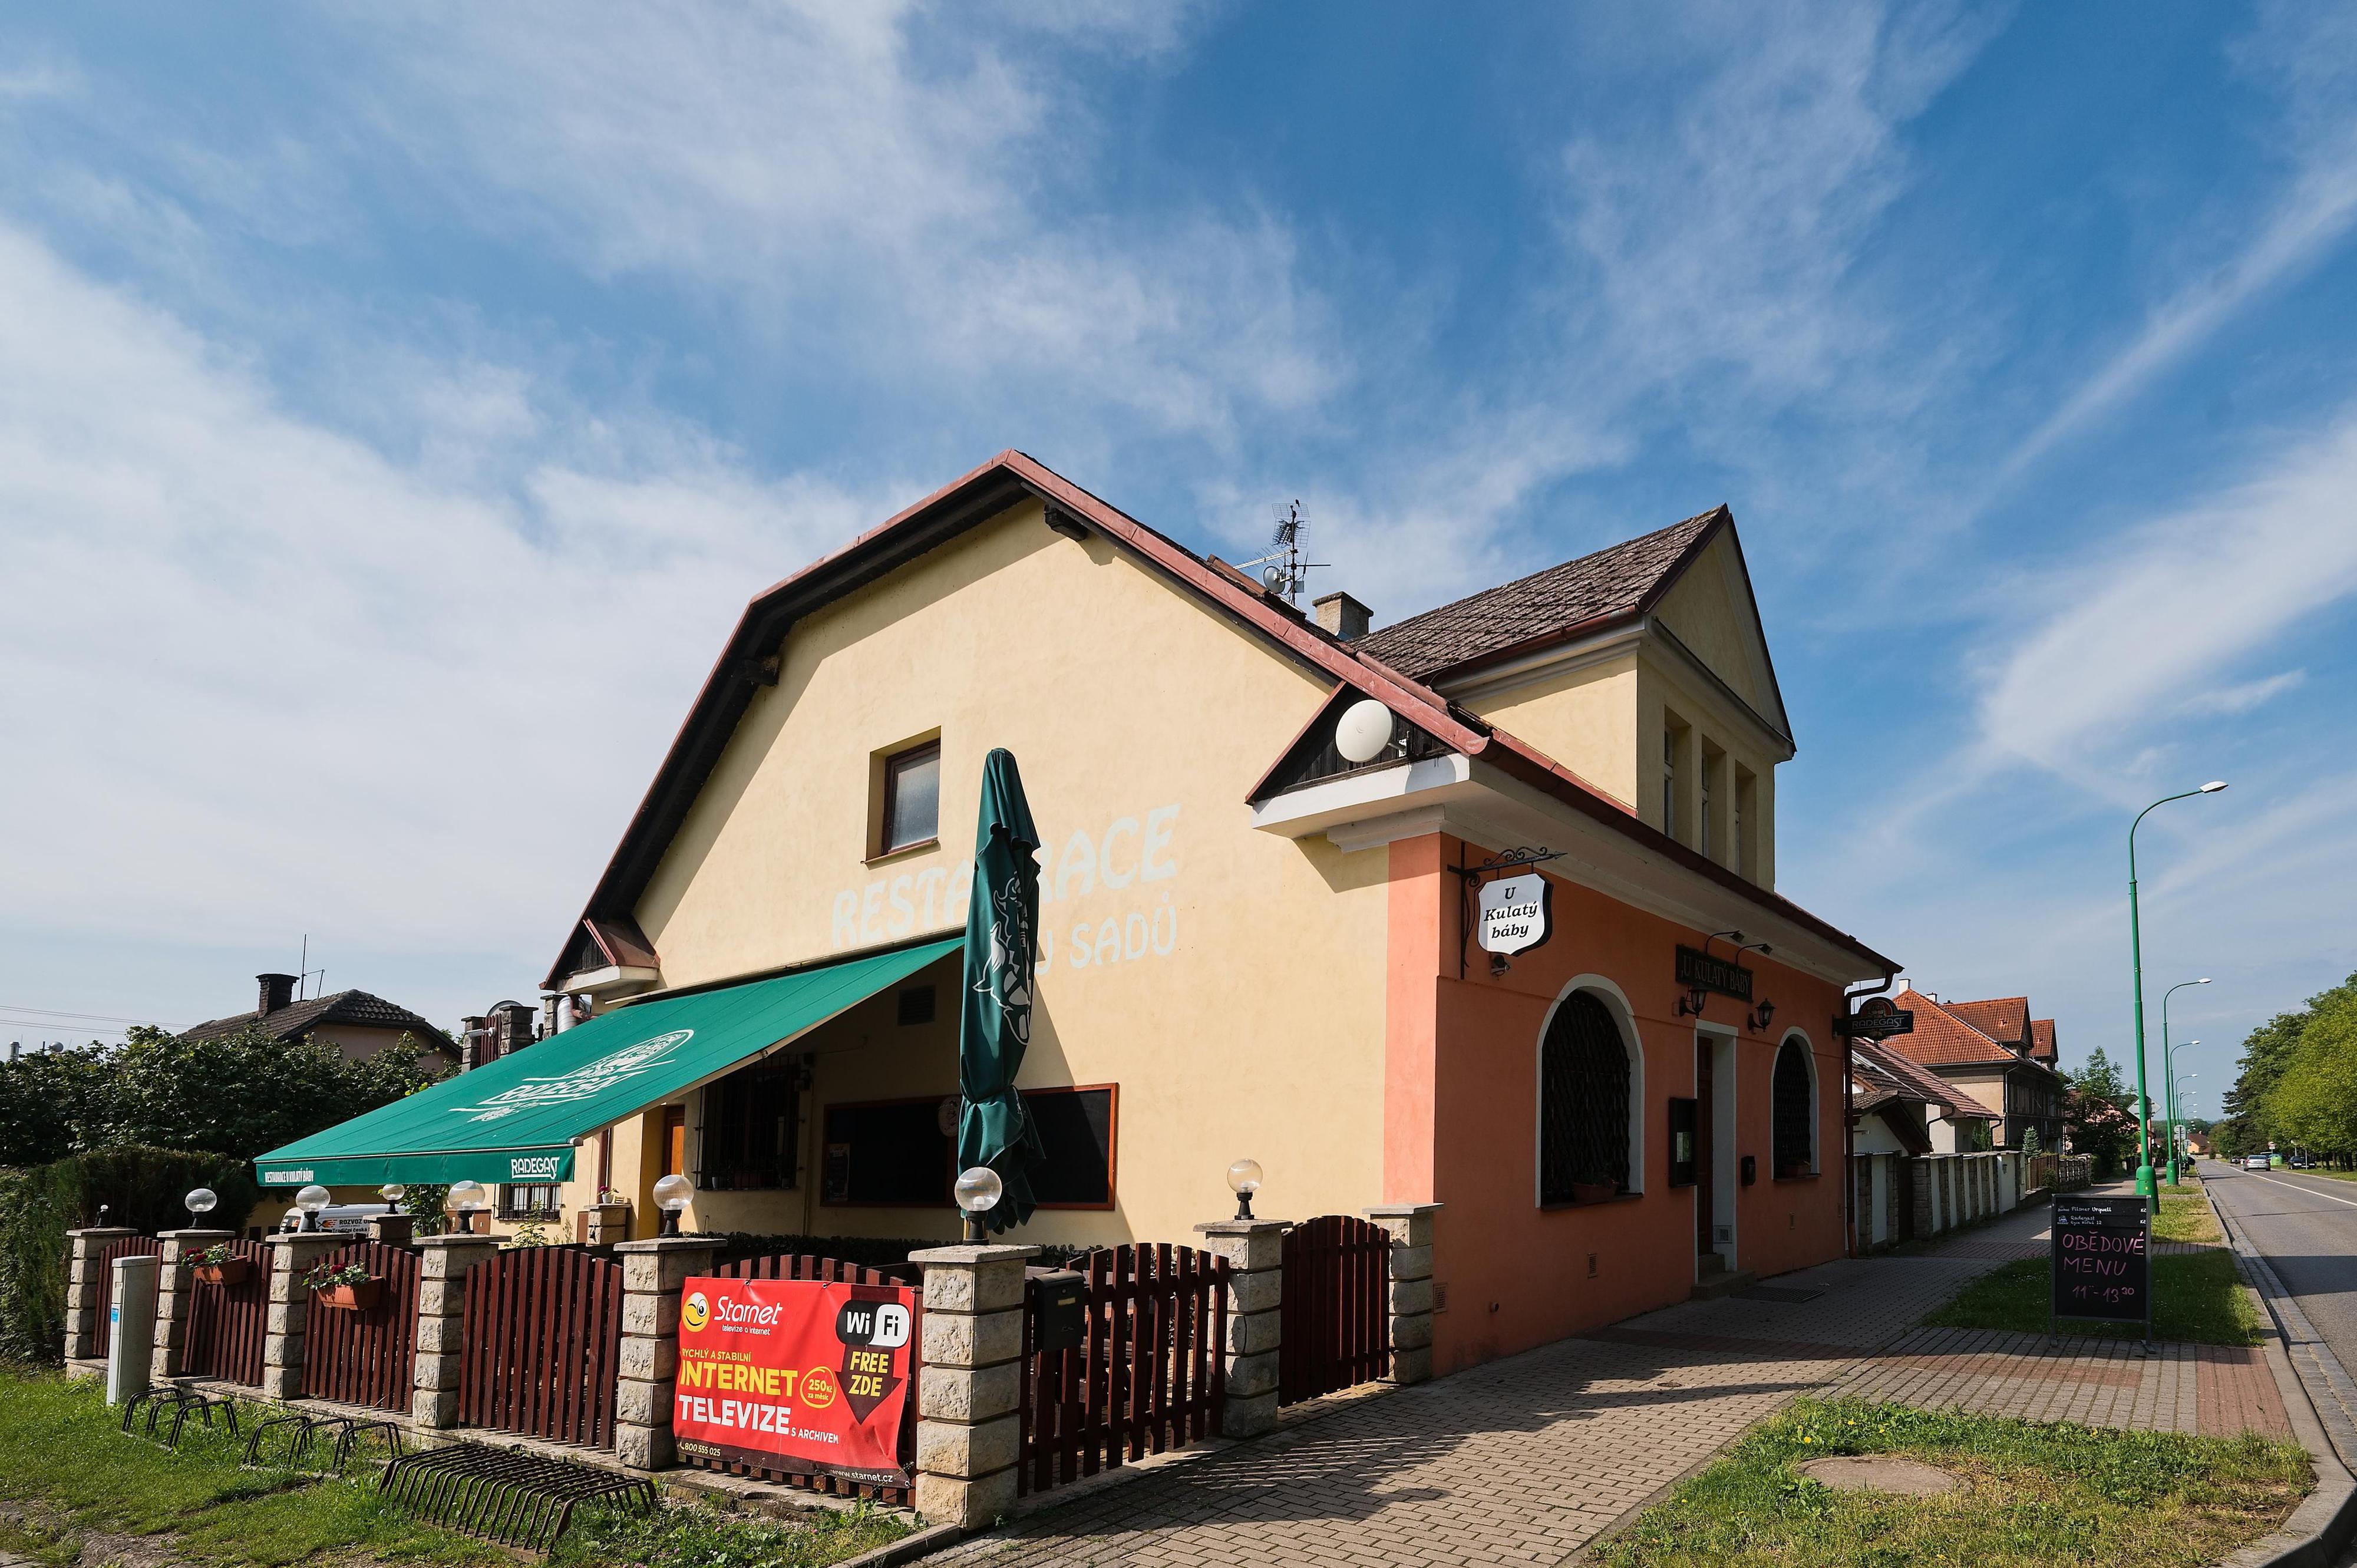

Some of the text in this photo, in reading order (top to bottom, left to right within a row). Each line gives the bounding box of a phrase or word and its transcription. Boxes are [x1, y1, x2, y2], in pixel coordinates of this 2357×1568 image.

[831, 803, 1181, 949] RESTARACE
[1505, 886, 1516, 900] U
[1484, 901, 1538, 922] Kulatý
[1069, 891, 1178, 969] SADŮ
[1491, 923, 1529, 939] báby
[1695, 959, 1728, 988] KULATÝ
[1729, 968, 1750, 995] BÁBY
[1851, 1016, 1905, 1029] RADEGAST
[511, 1156, 560, 1179] RADEGAST
[2062, 1230, 2145, 1255] OBĚDOVÉ
[2064, 1256, 2127, 1276] MENU
[714, 1296, 783, 1325] Starnet
[722, 1324, 743, 1333] televize
[750, 1326, 771, 1336] internet
[682, 1348, 709, 1358] RYCHLÝ
[718, 1351, 751, 1362] STABILNÍ
[849, 1351, 889, 1374] FREE
[679, 1359, 798, 1398] INTERNET
[808, 1379, 833, 1393] 250 Kč
[848, 1374, 883, 1397] ZDE
[678, 1394, 839, 1444] TELEVIZE S ARCHIVEM
[685, 1442, 721, 1457] 800 555 025
[830, 1469, 893, 1483] www.starnet.cz
